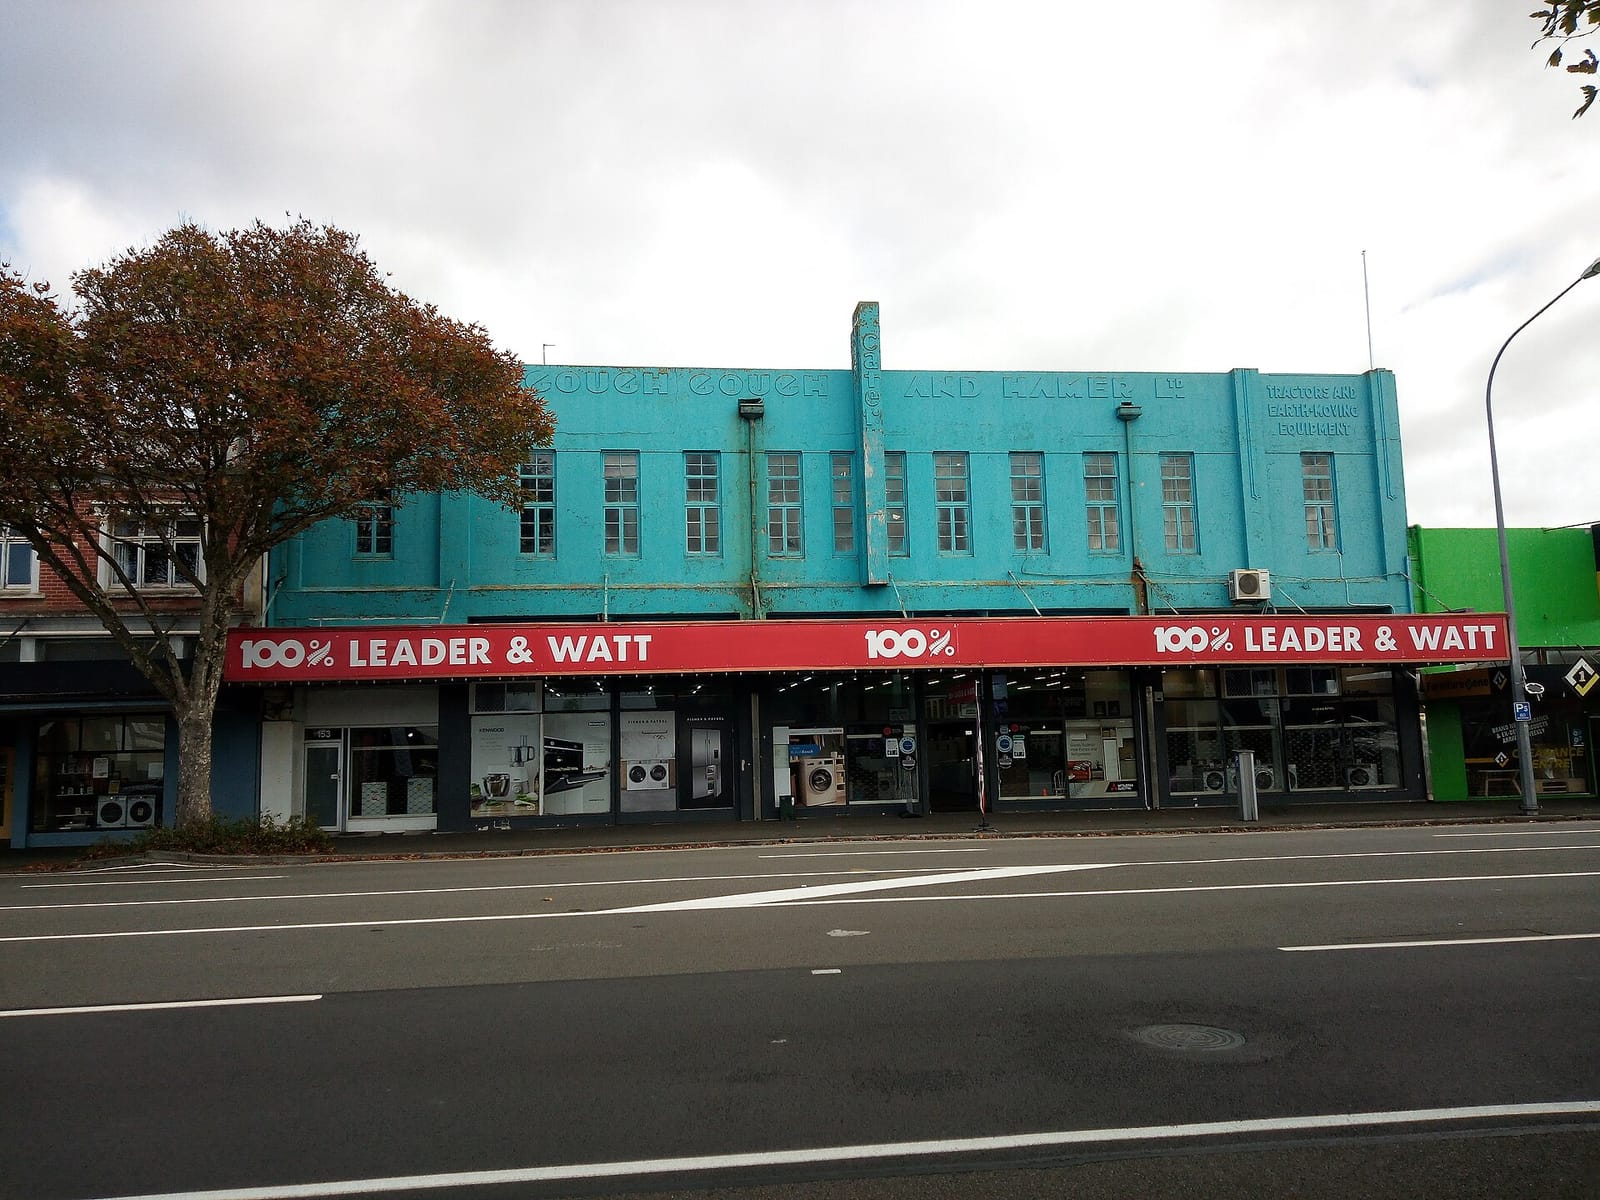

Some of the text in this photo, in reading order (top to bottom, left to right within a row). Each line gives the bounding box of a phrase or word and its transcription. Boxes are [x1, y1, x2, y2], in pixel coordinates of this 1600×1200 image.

[525, 370, 829, 397] GOUGH GOUGH
[903, 375, 981, 399] AND
[1002, 375, 1135, 400] HAMER
[1266, 384, 1357, 400] TRACTORS AND
[1267, 403, 1358, 418] EARTH-MOVING
[1278, 422, 1350, 437] EQUIPMENT
[240, 634, 653, 669] 100% LEADER & WATT
[864, 629, 956, 659] 100%
[1153, 625, 1497, 653] 100% LEADER & WATT
[318, 730, 331, 738] 153
